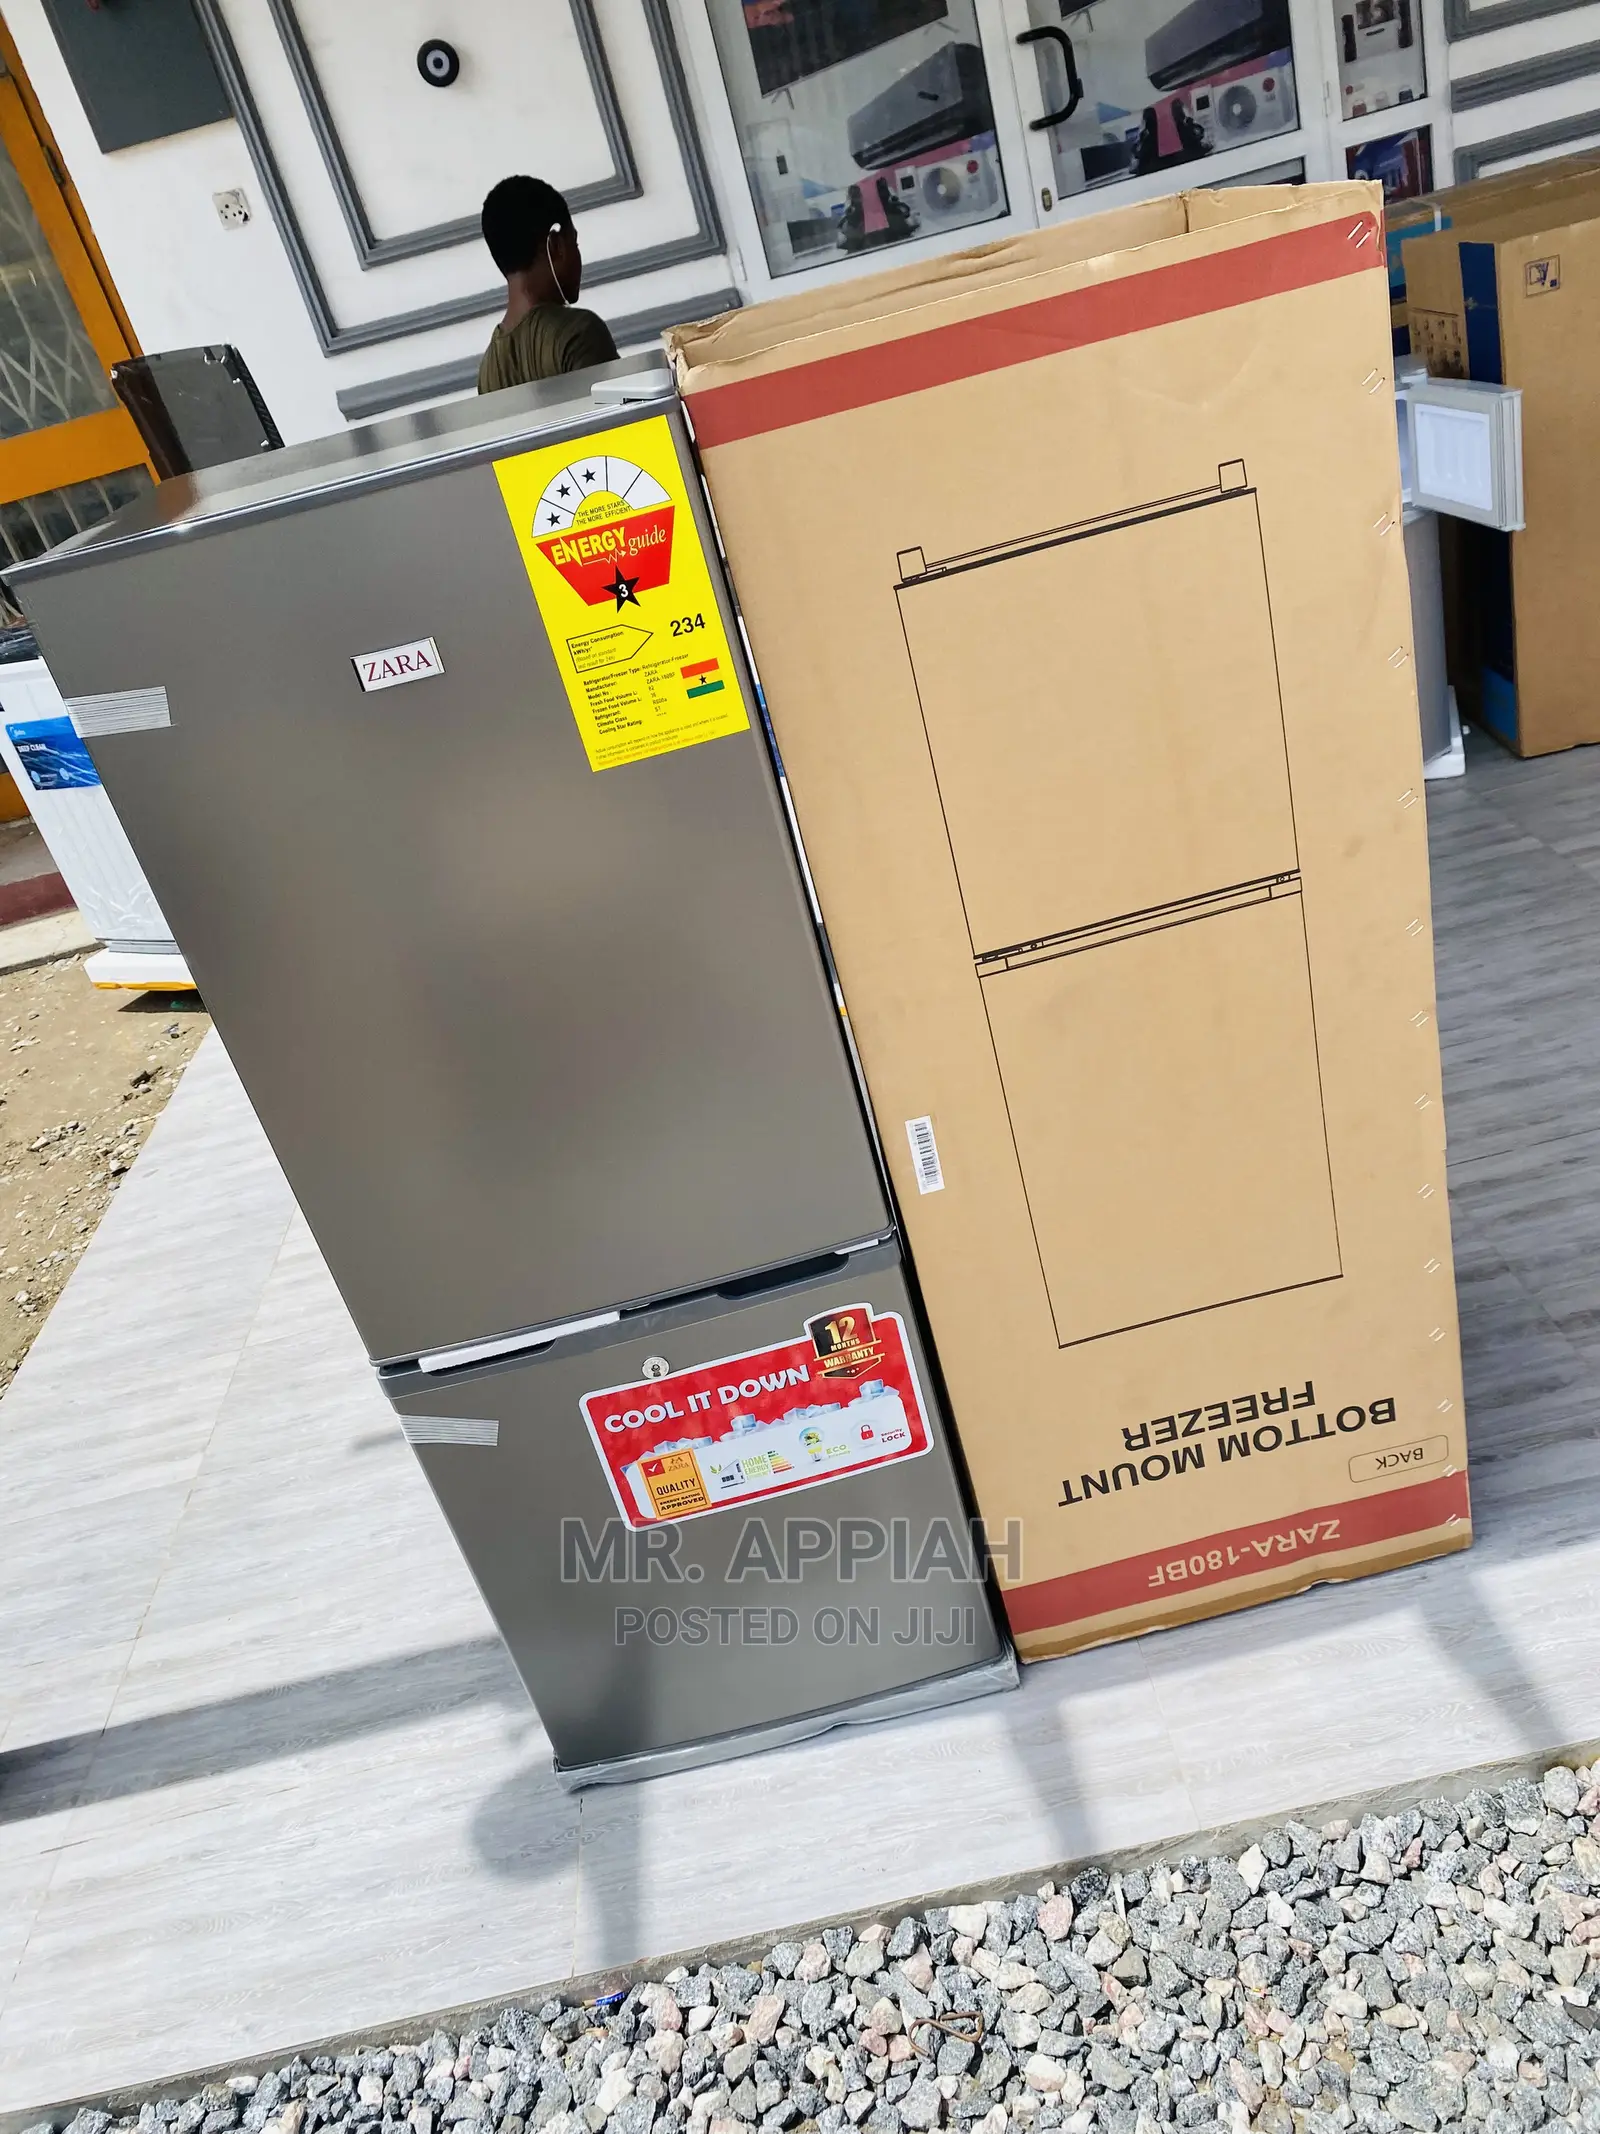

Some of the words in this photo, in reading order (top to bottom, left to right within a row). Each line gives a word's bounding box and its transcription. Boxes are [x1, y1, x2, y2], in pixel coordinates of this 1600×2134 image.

[576, 518, 587, 526] THE
[587, 513, 603, 522] MORE
[604, 505, 632, 518] EFFICIENT
[578, 509, 589, 518] THE
[589, 505, 606, 514] MORE
[606, 499, 626, 510] STARS
[551, 526, 625, 567] ENERGY
[628, 525, 667, 557] guide
[618, 583, 629, 598] 3
[670, 613, 706, 637] 234
[571, 639, 590, 650] Energy
[589, 629, 624, 644] Consumption
[363, 650, 432, 682] ZARA
[644, 669, 658, 678] ZARA
[588, 692, 602, 700] Model
[590, 699, 604, 707] Fresh
[615, 691, 633, 700] Volume
[592, 706, 608, 714] Frozen
[608, 702, 620, 710] Food
[620, 698, 637, 706] Volume
[596, 719, 614, 728] Climate
[599, 726, 616, 735] Cooling
[825, 1316, 858, 1344] 12
[830, 1338, 861, 1352] MONTHS
[823, 1346, 875, 1369] WARRANTY
[604, 1401, 684, 1433] COOL
[687, 1390, 712, 1414] IT
[717, 1364, 811, 1405] DOWN
[1122, 1380, 1316, 1452] FREEZER
[882, 1431, 906, 1443] LOCK
[1219, 1397, 1397, 1463] BOTTOM
[826, 1444, 847, 1455] ECO
[741, 1453, 768, 1470] HOME
[1375, 1447, 1424, 1471] BACK
[744, 1463, 769, 1476] ENERGY
[1058, 1444, 1206, 1507] MOUNT
[656, 1478, 696, 1496] QUALITY
[660, 1497, 704, 1511] APPROVED
[1148, 1519, 1341, 1588] ZARA-180BF
